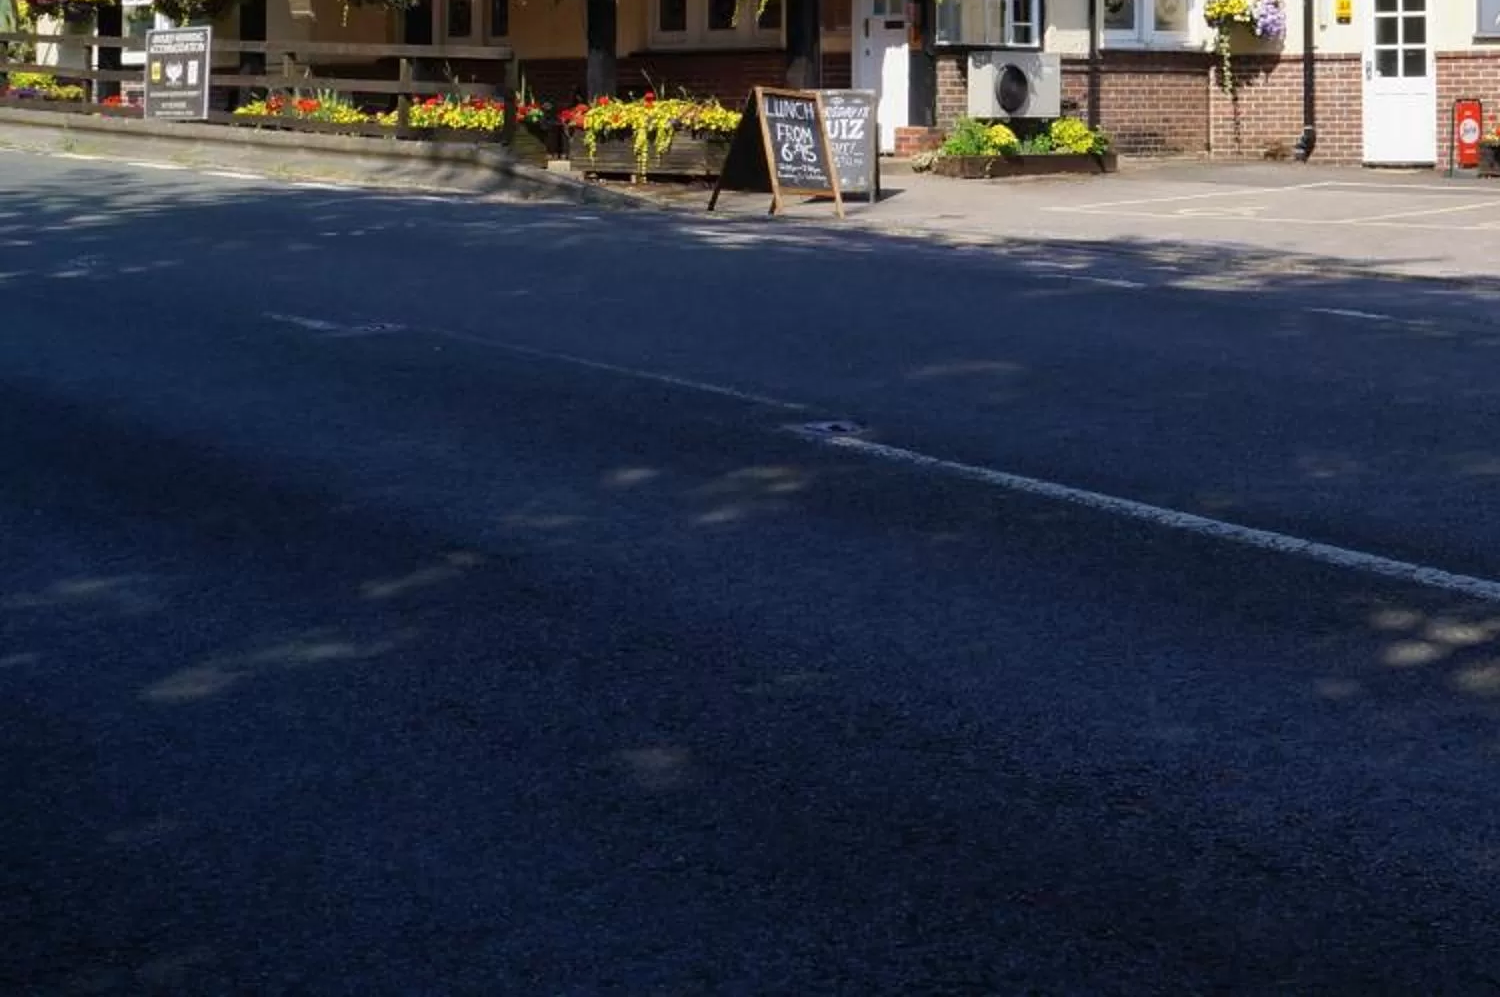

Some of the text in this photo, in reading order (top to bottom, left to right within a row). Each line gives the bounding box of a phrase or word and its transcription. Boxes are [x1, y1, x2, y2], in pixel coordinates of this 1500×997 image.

[765, 98, 815, 119] LUNCH
[775, 122, 814, 145] FROM
[826, 118, 866, 140] UIZ
